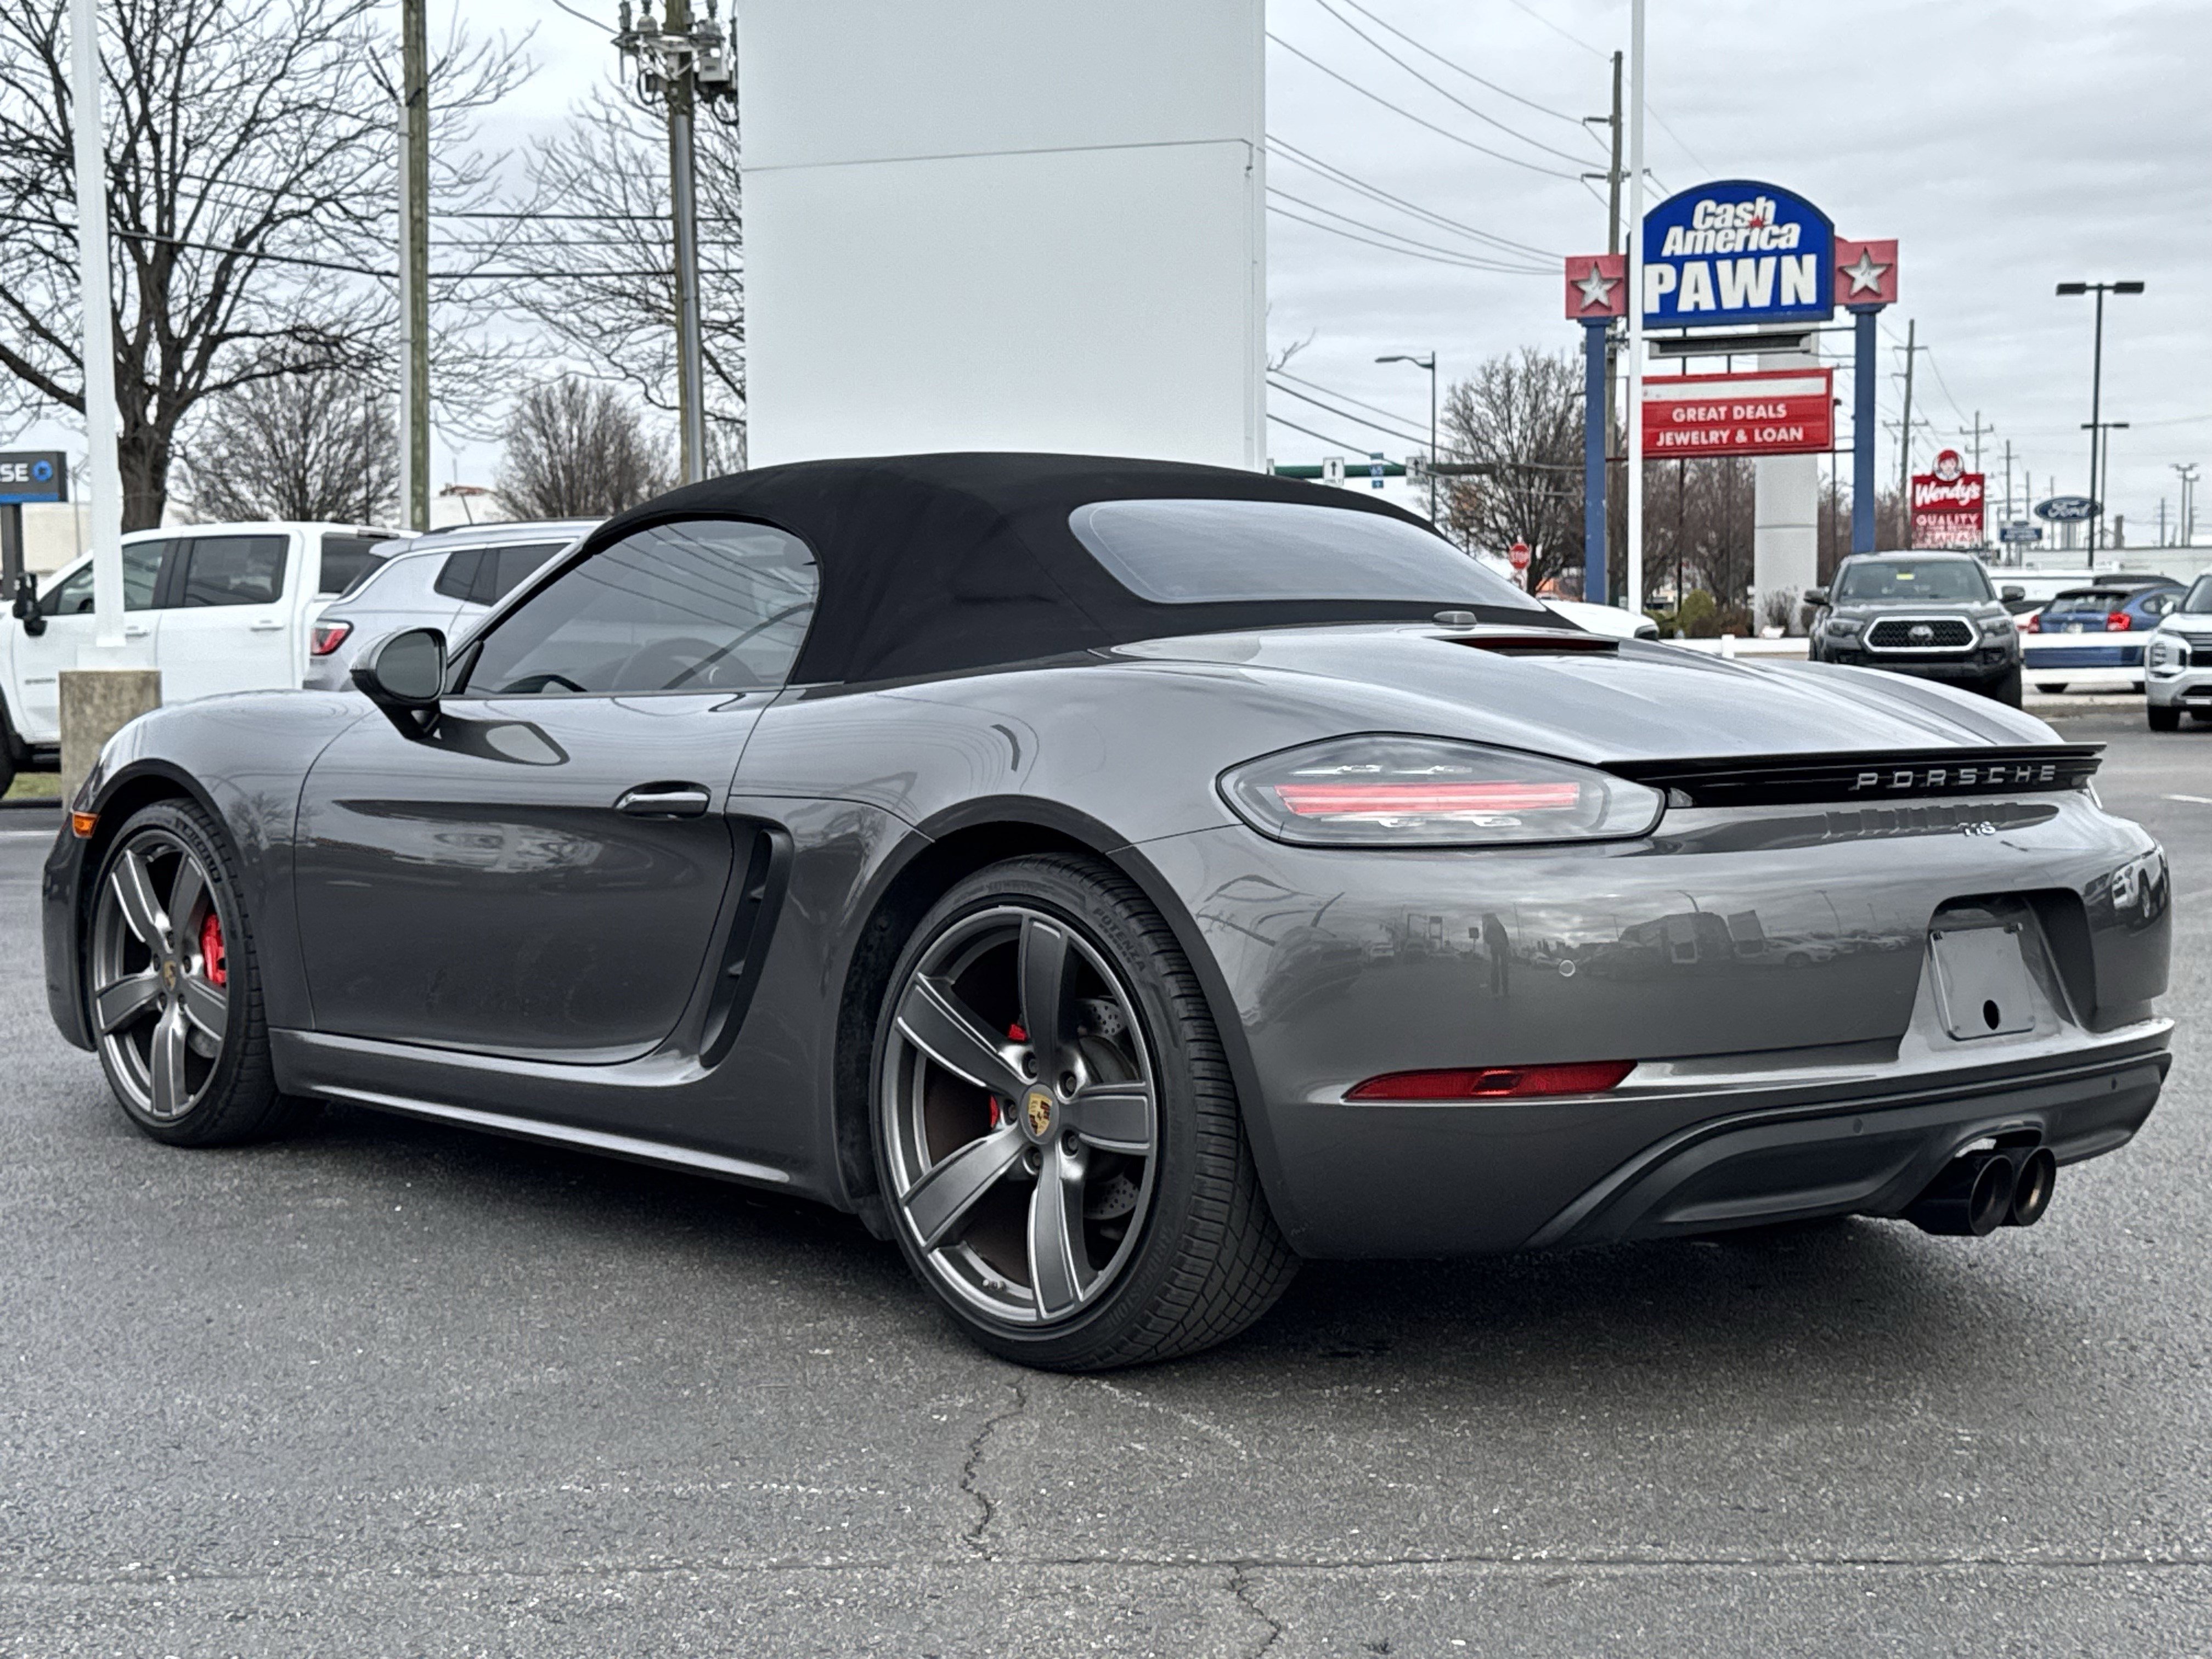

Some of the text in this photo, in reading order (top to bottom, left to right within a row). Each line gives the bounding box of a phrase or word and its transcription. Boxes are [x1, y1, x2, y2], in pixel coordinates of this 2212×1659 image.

[1692, 196, 1776, 230] Cash
[1661, 223, 1801, 257] America
[1644, 254, 1816, 314] PAWN
[1672, 403, 1787, 422] GREAT DEALS
[1656, 426, 1804, 447] JEWELRY & LOAN
[1915, 478, 1982, 507] Wendy's
[1916, 512, 1980, 526] QUALITY
[2047, 500, 2092, 518] Ford
[1510, 550, 1530, 563] STOP
[1855, 765, 2056, 790] PORSCHE
[1092, 907, 1147, 972] POTENZA
